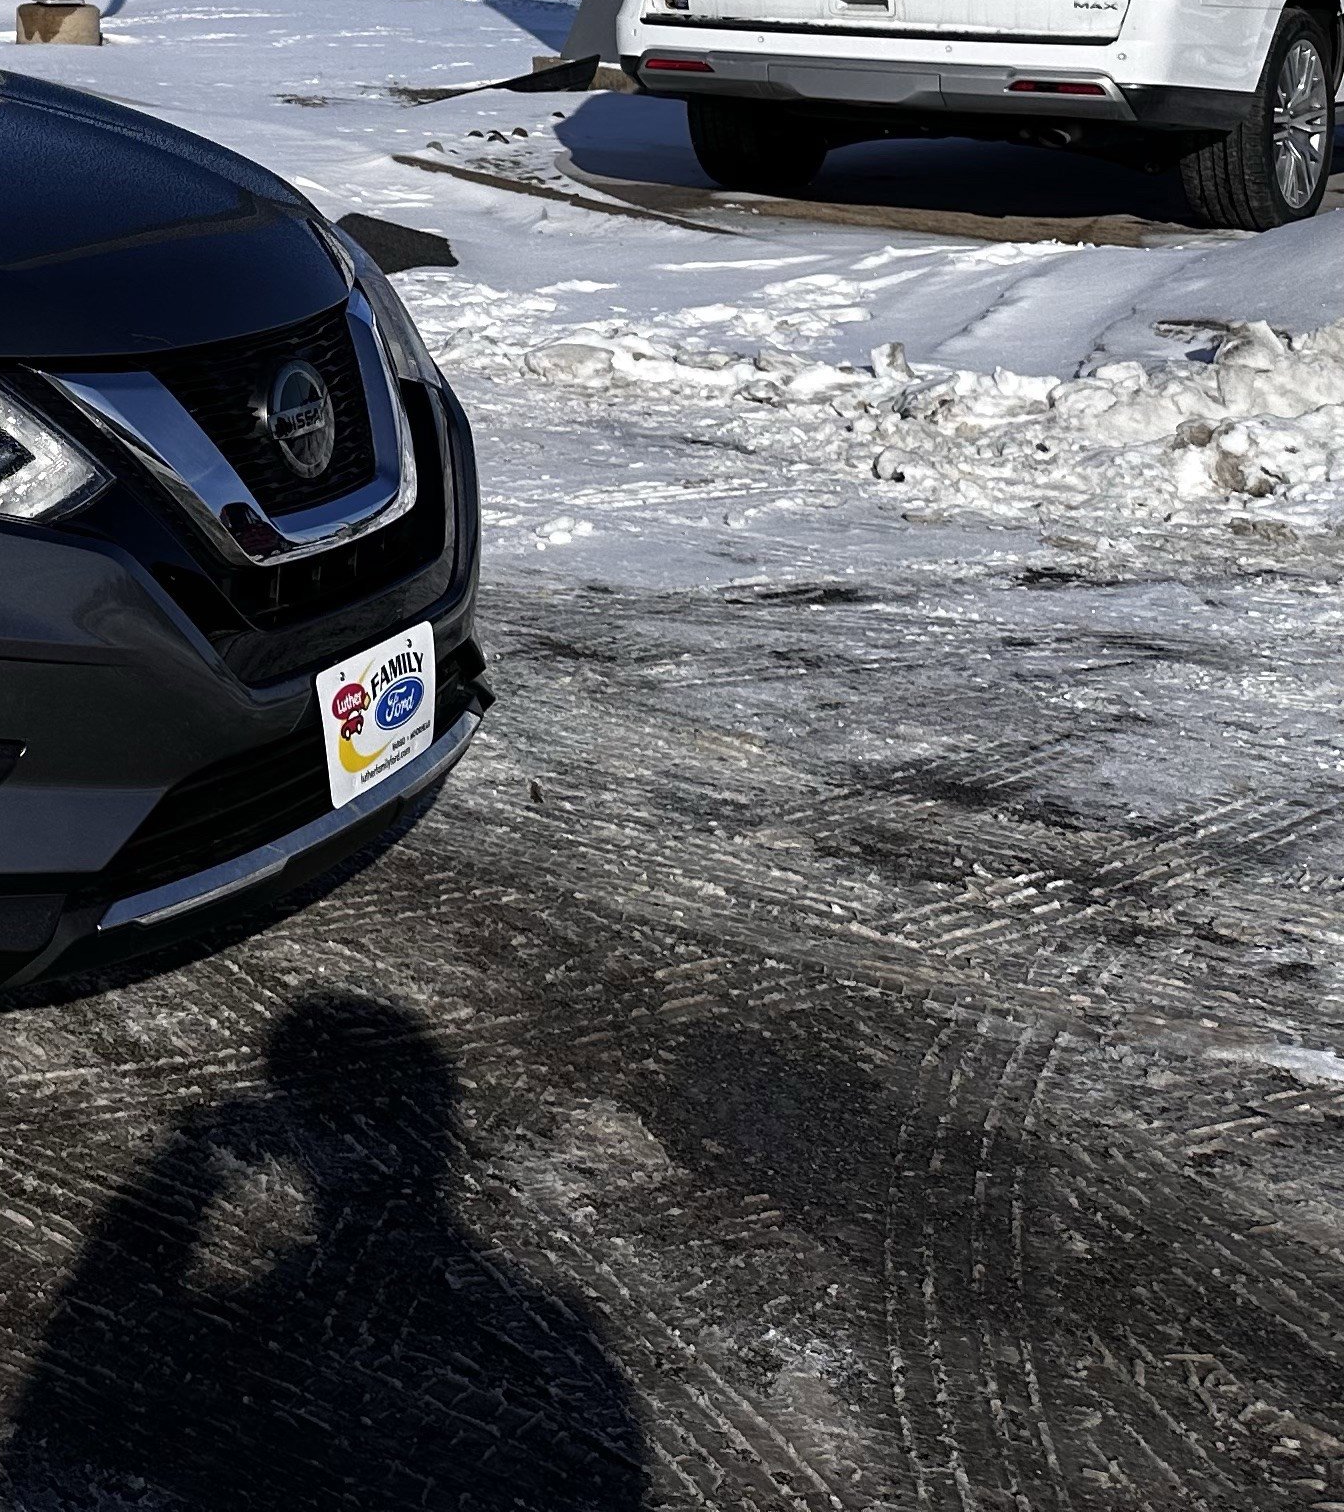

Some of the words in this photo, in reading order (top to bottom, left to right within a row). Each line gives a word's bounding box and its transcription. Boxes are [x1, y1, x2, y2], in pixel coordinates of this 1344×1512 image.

[1073, 0, 1118, 10] MAX
[370, 651, 424, 701] FAMILY
[336, 690, 362, 715] Luther
[385, 685, 415, 722] Ford
[361, 746, 411, 783] lutherfamilyford.com
